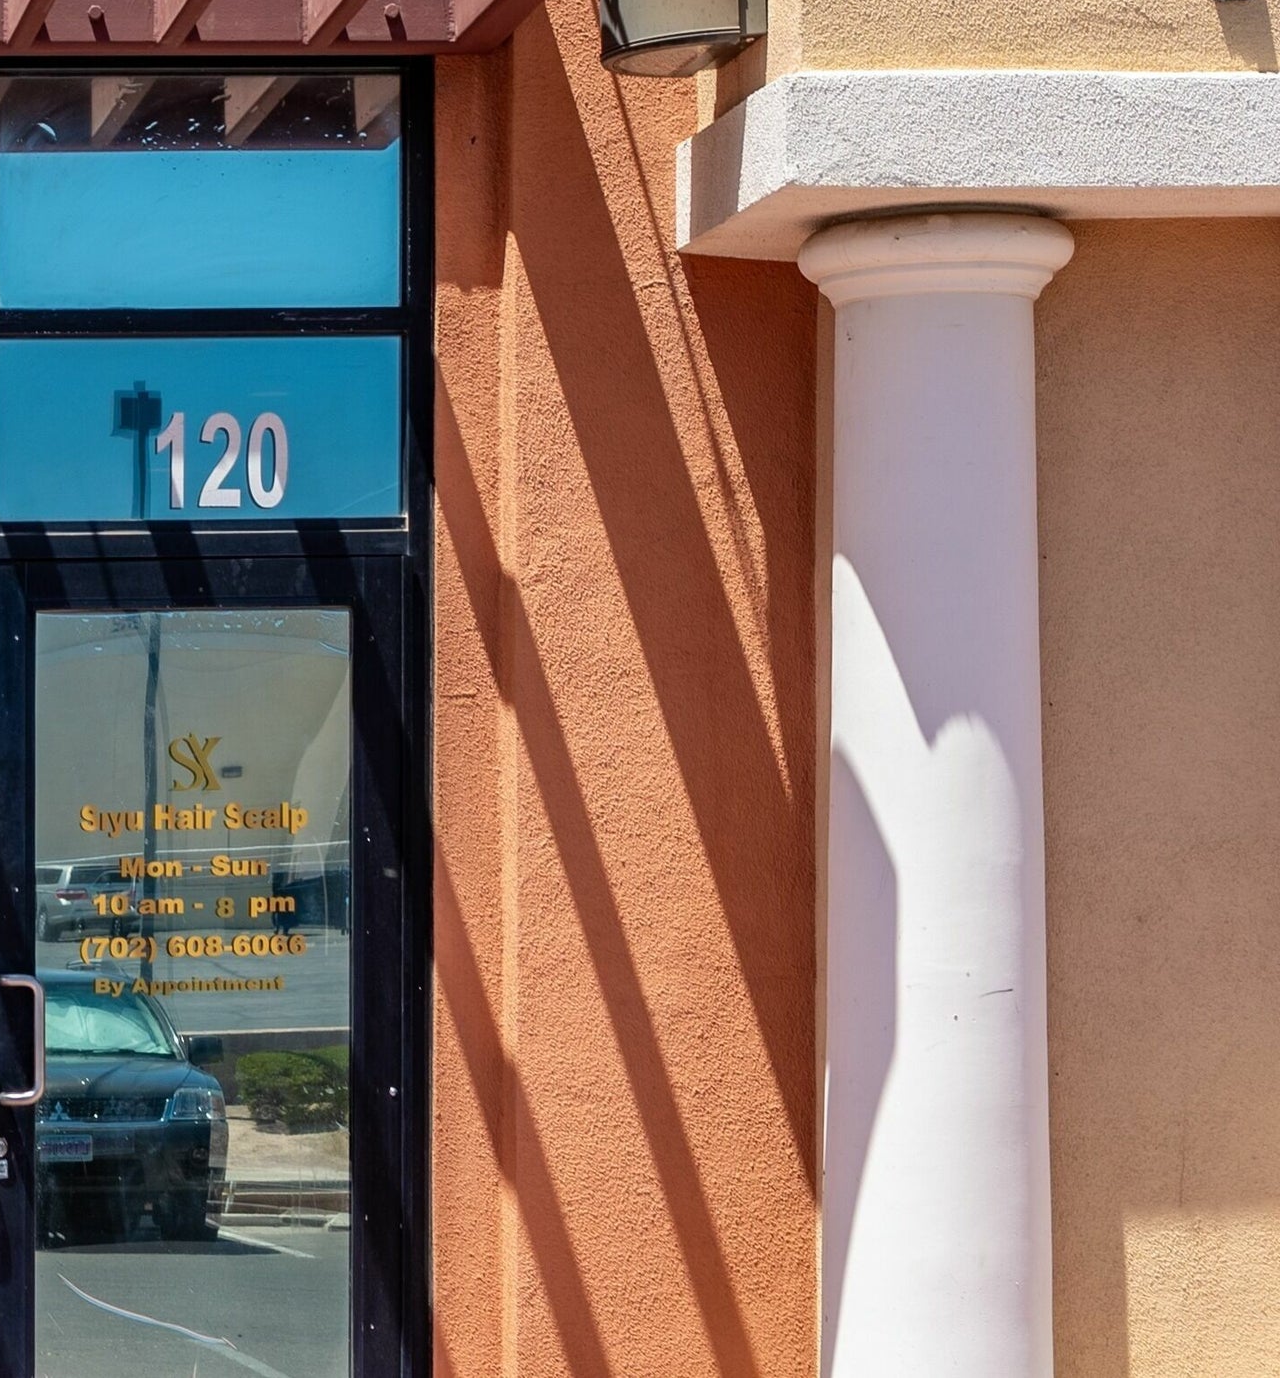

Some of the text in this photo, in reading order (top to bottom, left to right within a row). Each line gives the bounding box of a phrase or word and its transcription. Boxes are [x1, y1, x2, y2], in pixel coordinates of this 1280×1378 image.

[155, 411, 288, 509] 120
[80, 802, 308, 838] Siyu Hair Scalp
[120, 857, 183, 878] Mon
[210, 855, 268, 877] Sun
[92, 894, 129, 916] 10
[138, 897, 184, 914] am
[216, 897, 235, 918] 8
[248, 895, 295, 918] pm
[80, 934, 307, 964] (702) 608-6066
[94, 975, 285, 998] By Appointment
